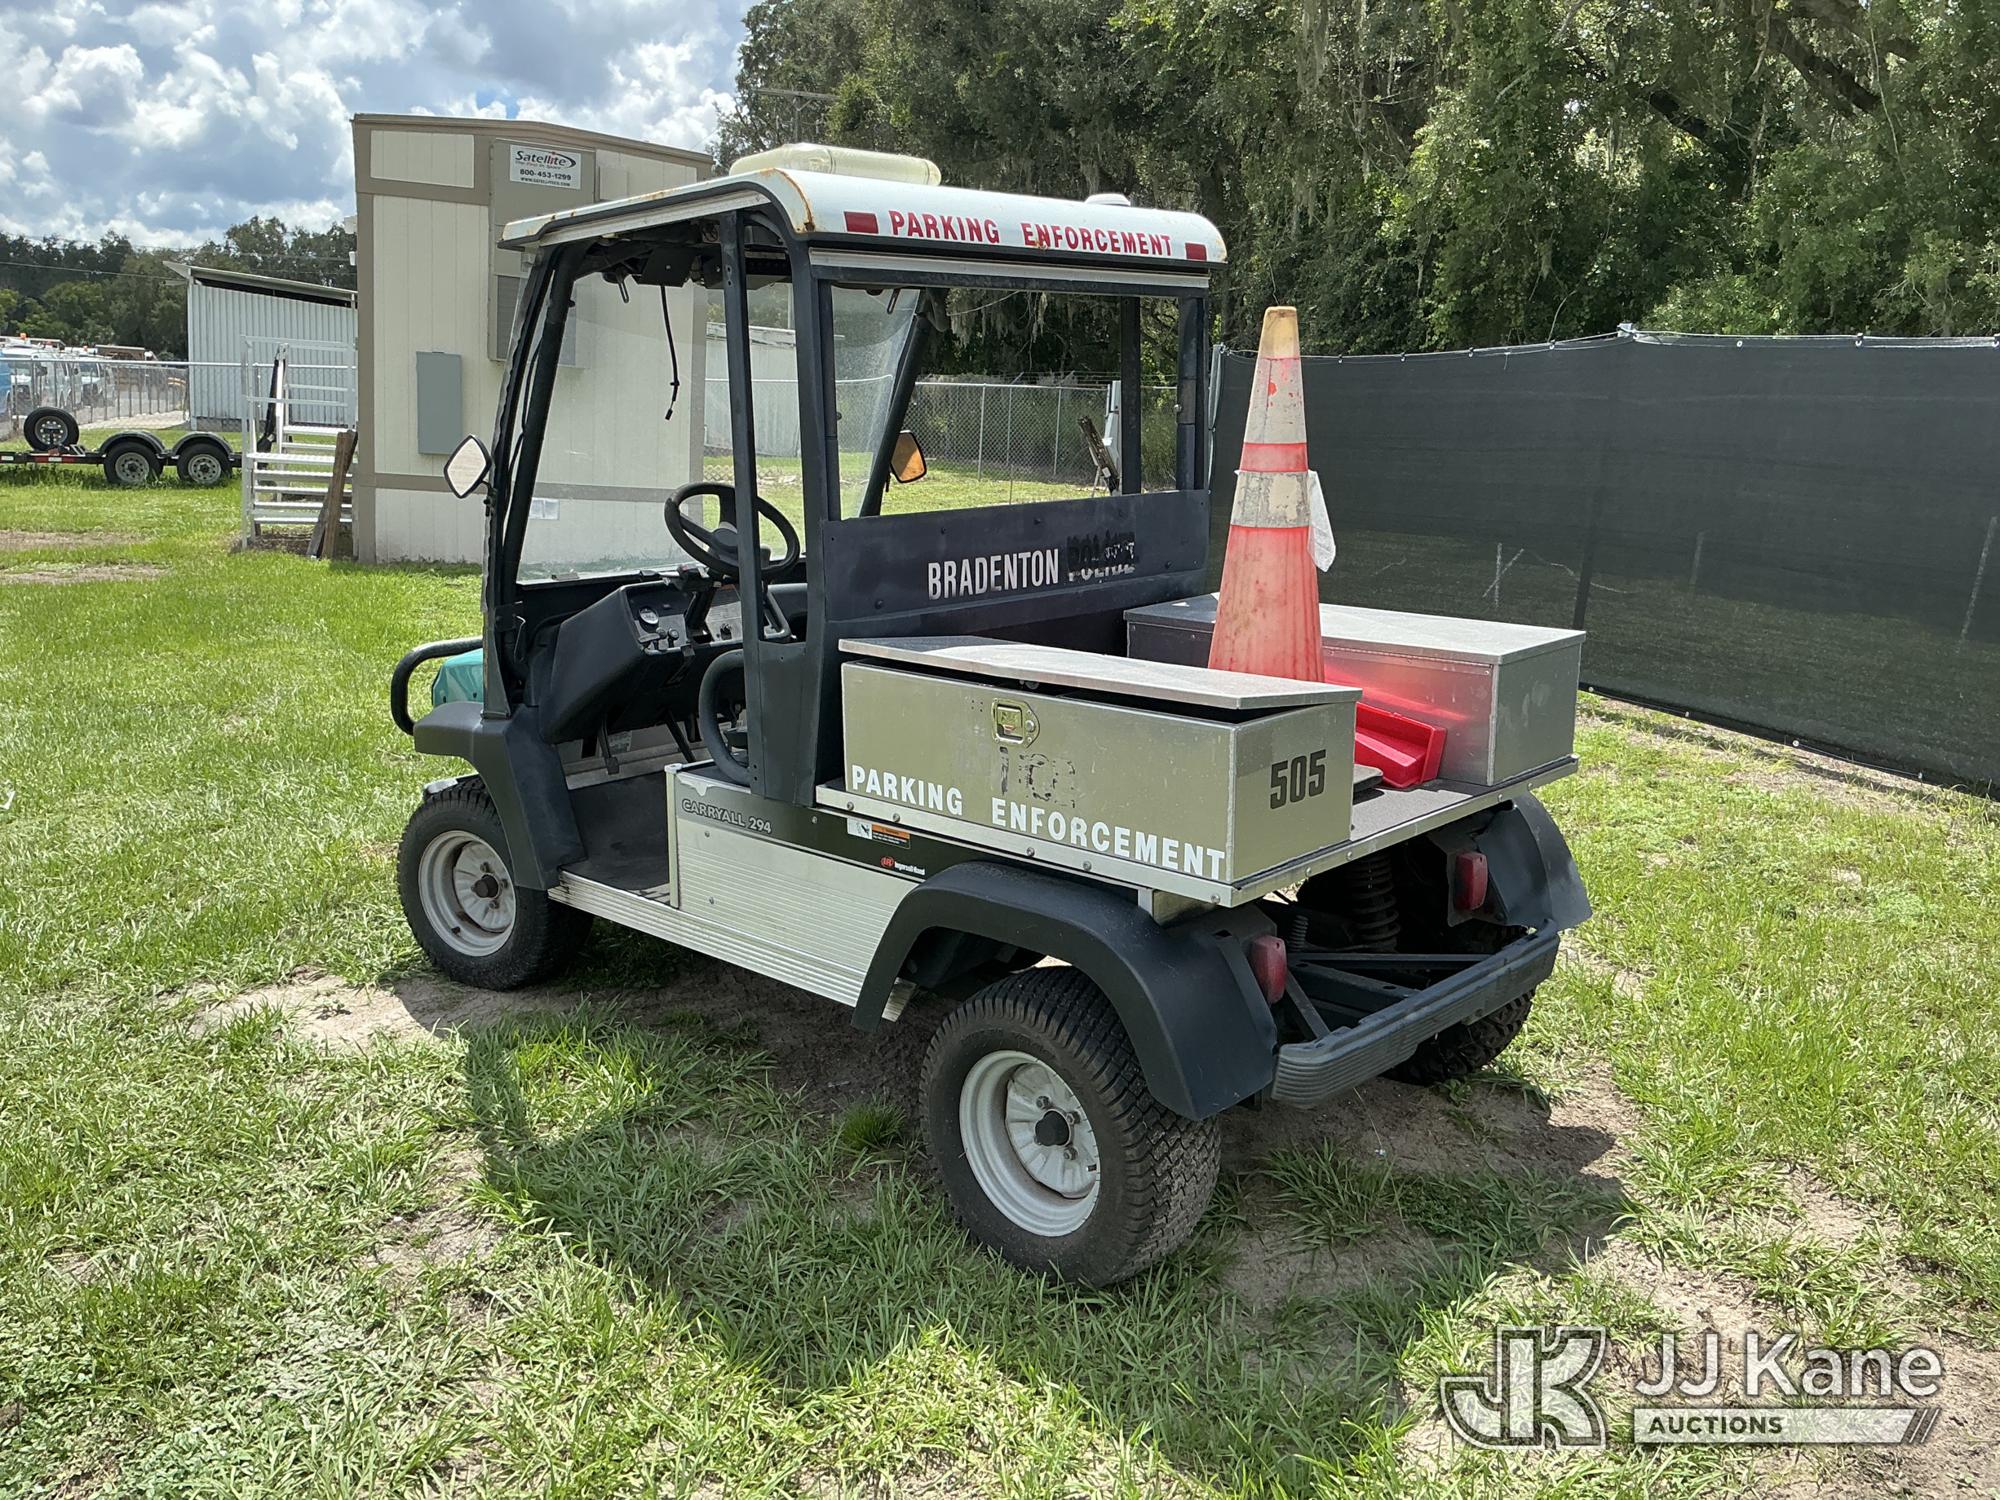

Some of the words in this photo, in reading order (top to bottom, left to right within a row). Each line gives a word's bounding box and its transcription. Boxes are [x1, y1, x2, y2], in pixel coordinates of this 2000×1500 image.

[515, 150, 567, 166] Satellite
[520, 168, 571, 181] 800-453-1299
[888, 210, 999, 244] PARKING
[1021, 223, 1171, 256] ENFORCEMENT
[928, 548, 1059, 600] BRADENTON
[1270, 749, 1326, 809] 505
[682, 798, 746, 827] CARRYALL
[748, 816, 772, 834] 294
[852, 764, 963, 817] PARKING
[992, 796, 1225, 881] ENFORCEMENT
